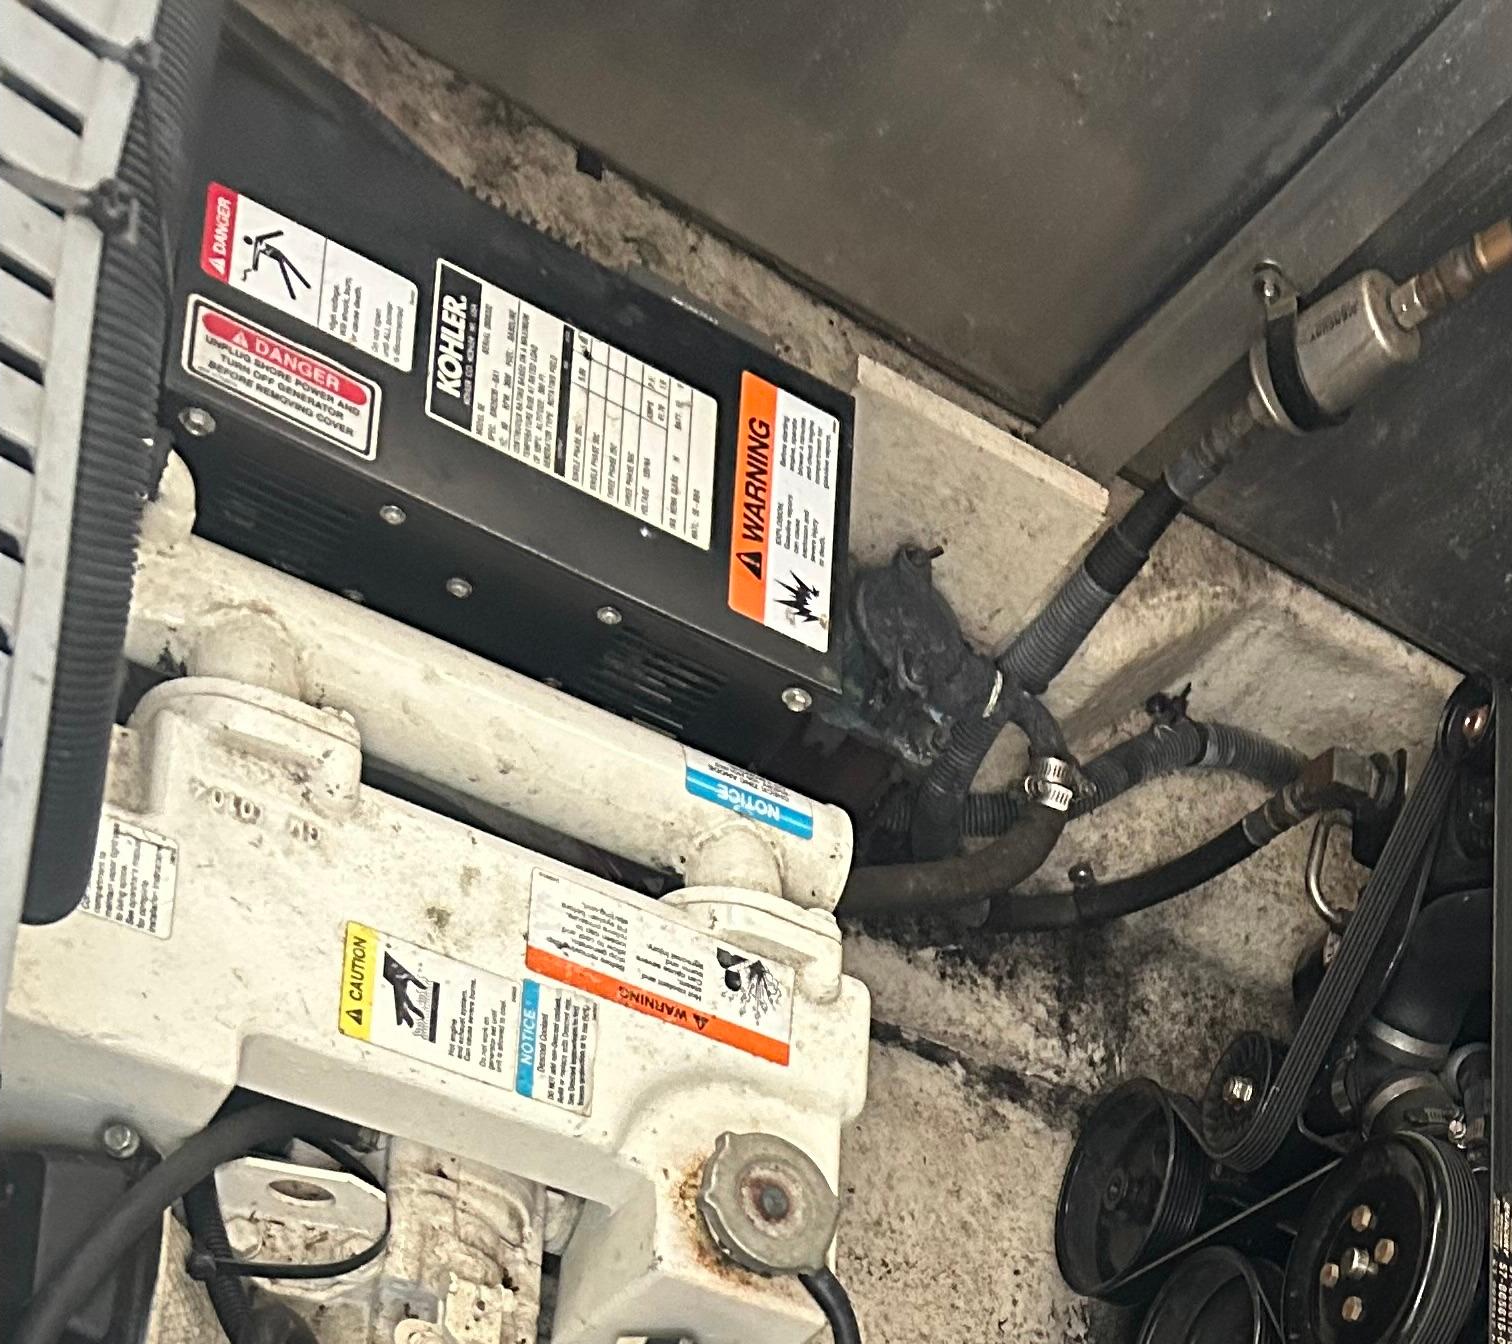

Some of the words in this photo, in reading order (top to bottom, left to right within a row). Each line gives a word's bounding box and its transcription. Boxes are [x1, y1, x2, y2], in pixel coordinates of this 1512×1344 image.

[211, 193, 231, 256] DANGER
[205, 334, 251, 363] UNPLUG
[254, 358, 291, 383] SHORE
[294, 378, 334, 404] POWER
[337, 399, 360, 417] AND
[220, 352, 250, 375] TURN
[253, 369, 274, 386] OFF
[277, 381, 344, 420] GENERATOR
[254, 337, 340, 391] DANGER
[208, 359, 253, 388] BEFORE
[255, 382, 313, 417] REMOVING
[315, 411, 354, 437] COVER
[740, 414, 770, 546] WARNING
[716, 781, 779, 821] NOTICE
[347, 935, 367, 1002] CAUTION
[617, 984, 687, 1022] WARNING
[518, 1007, 537, 1065] NOTICE
